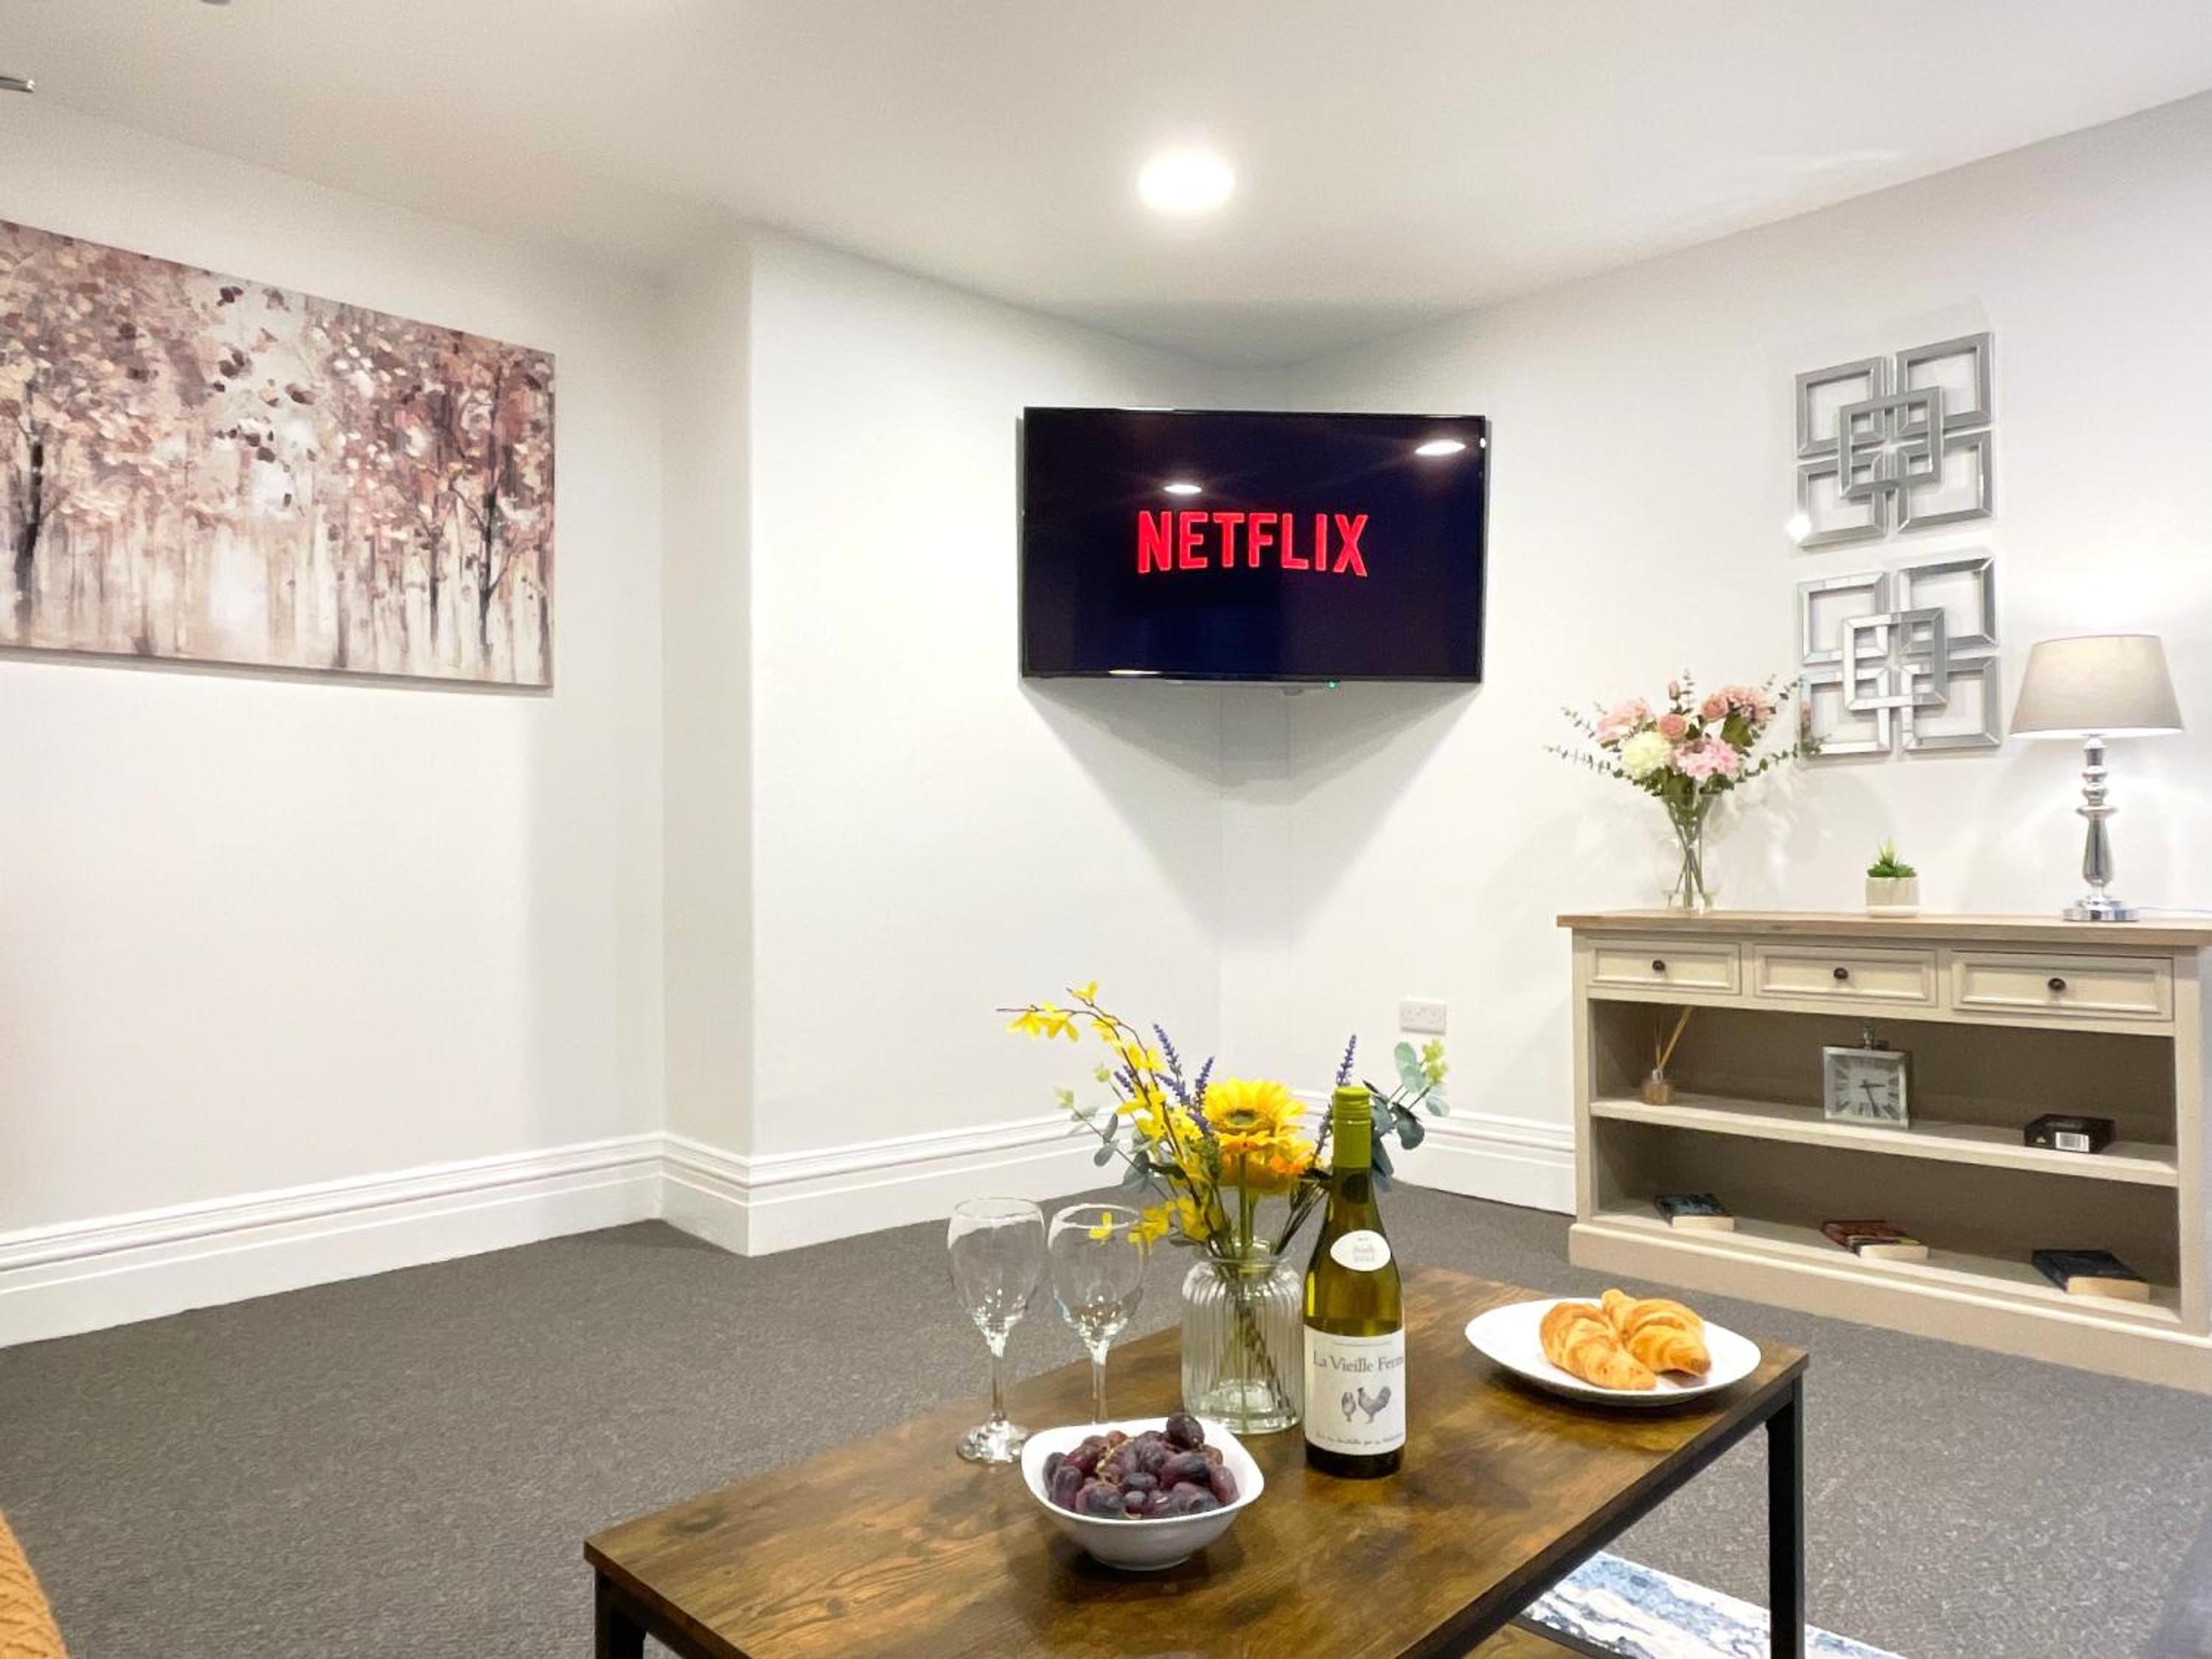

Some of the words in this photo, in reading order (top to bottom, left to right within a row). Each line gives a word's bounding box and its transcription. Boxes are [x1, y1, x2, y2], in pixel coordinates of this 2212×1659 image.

[1137, 510, 1368, 577] NETFLIX
[1313, 1350, 1327, 1368] La
[1328, 1355, 1374, 1373] Vieille
[1377, 1355, 1405, 1371] Ferm
